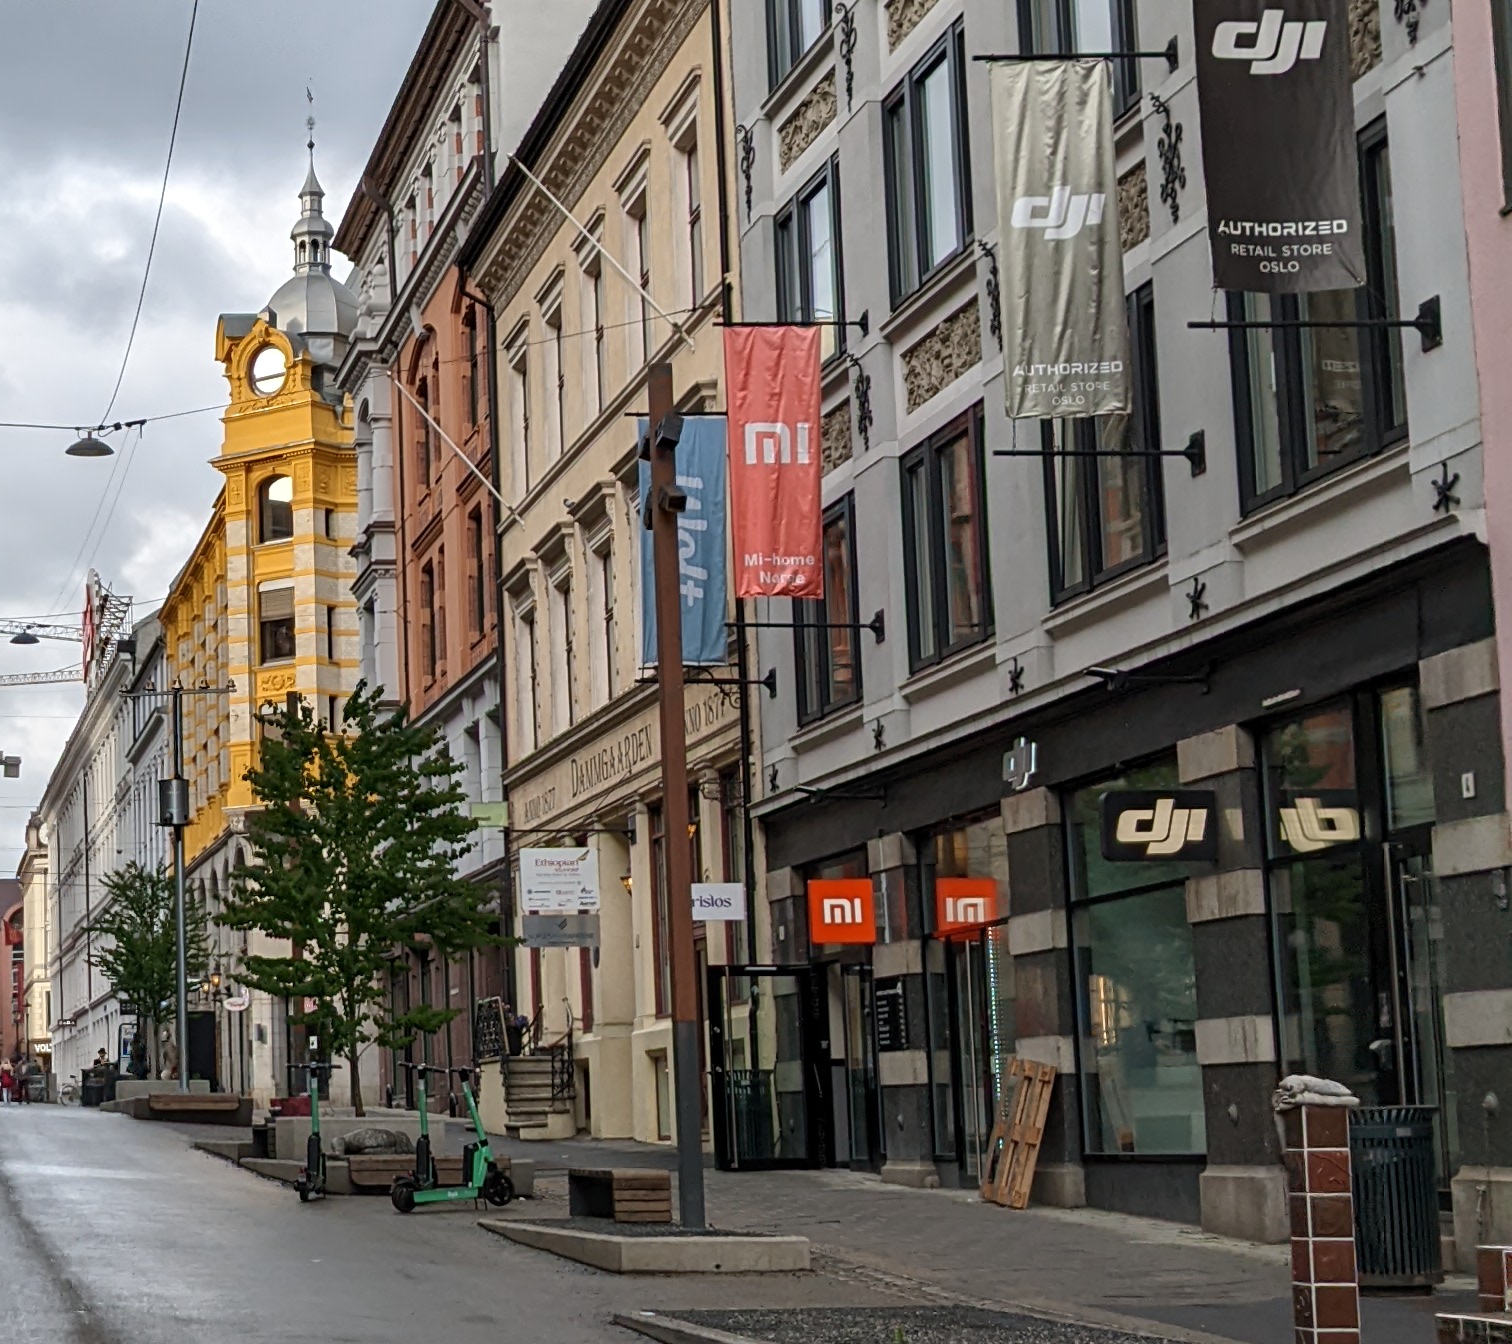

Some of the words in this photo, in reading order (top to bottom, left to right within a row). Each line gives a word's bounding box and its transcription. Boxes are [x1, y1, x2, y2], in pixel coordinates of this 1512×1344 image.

[1218, 219, 1347, 237] AUTHORIZED
[1231, 243, 1276, 257] RETAIL
[1282, 243, 1332, 256] STORE
[1260, 261, 1299, 273] OSLO
[1013, 361, 1123, 377] AUTHORIZED
[1024, 382, 1067, 393] RETAIL
[1071, 381, 1111, 392] STORE
[1052, 396, 1085, 405] OSLO
[744, 552, 815, 567] Mi-home
[571, 724, 653, 798] DAMMGAARDEN
